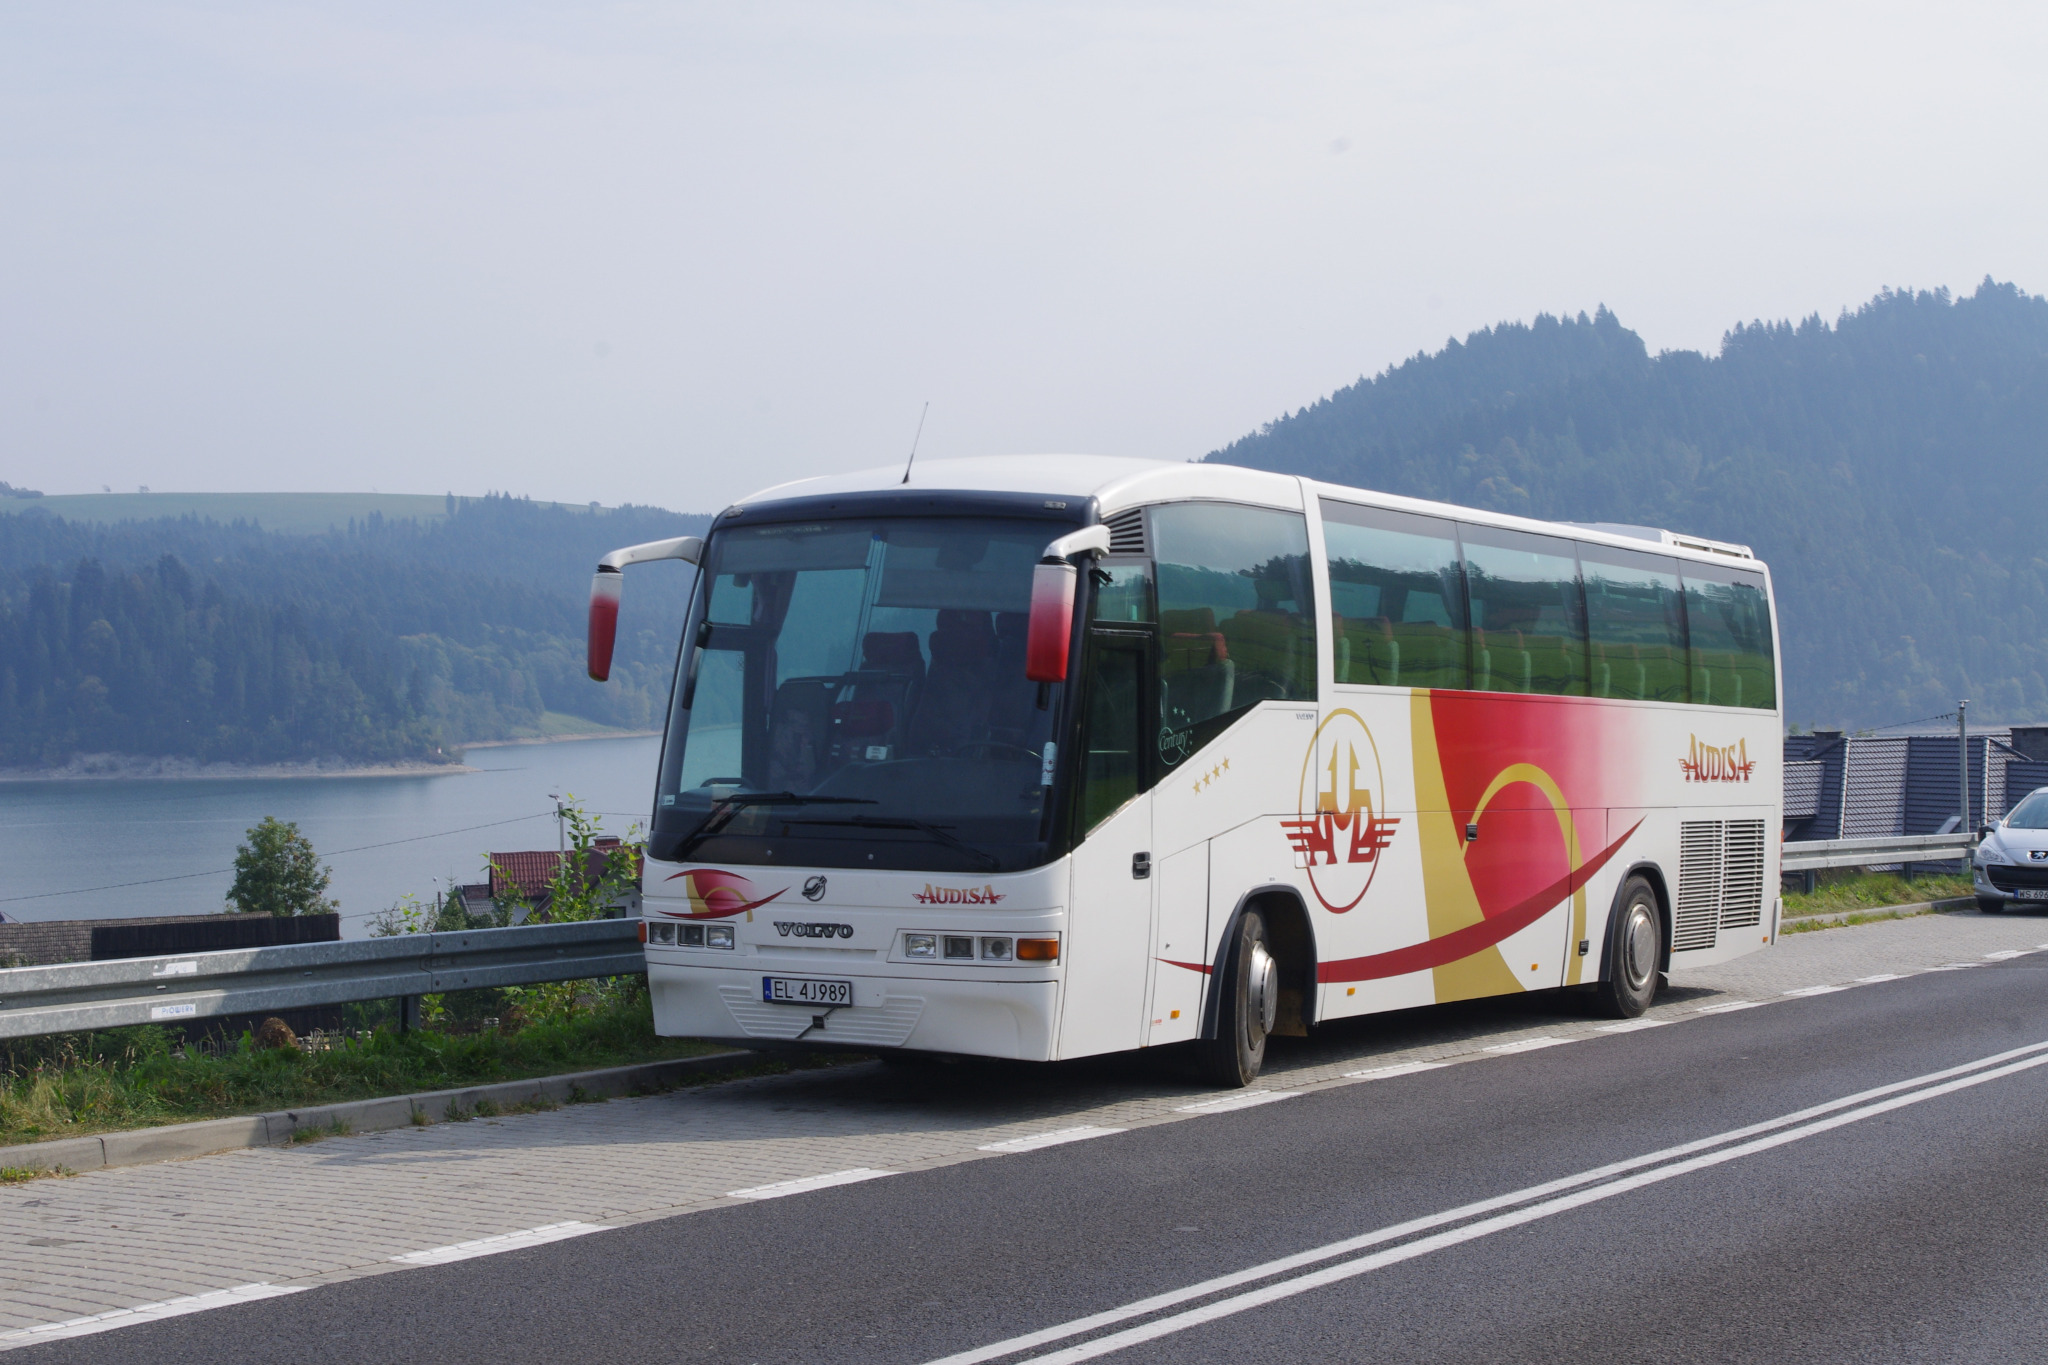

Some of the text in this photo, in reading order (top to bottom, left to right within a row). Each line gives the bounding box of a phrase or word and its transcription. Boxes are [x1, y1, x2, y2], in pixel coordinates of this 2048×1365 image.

[1160, 731, 1187, 751] Century
[1685, 732, 1751, 783] AUDISA
[919, 883, 998, 904] AUDISA
[2019, 889, 2031, 899] WS
[773, 921, 854, 939] VOLVO
[774, 981, 847, 1002] EL 4J989
